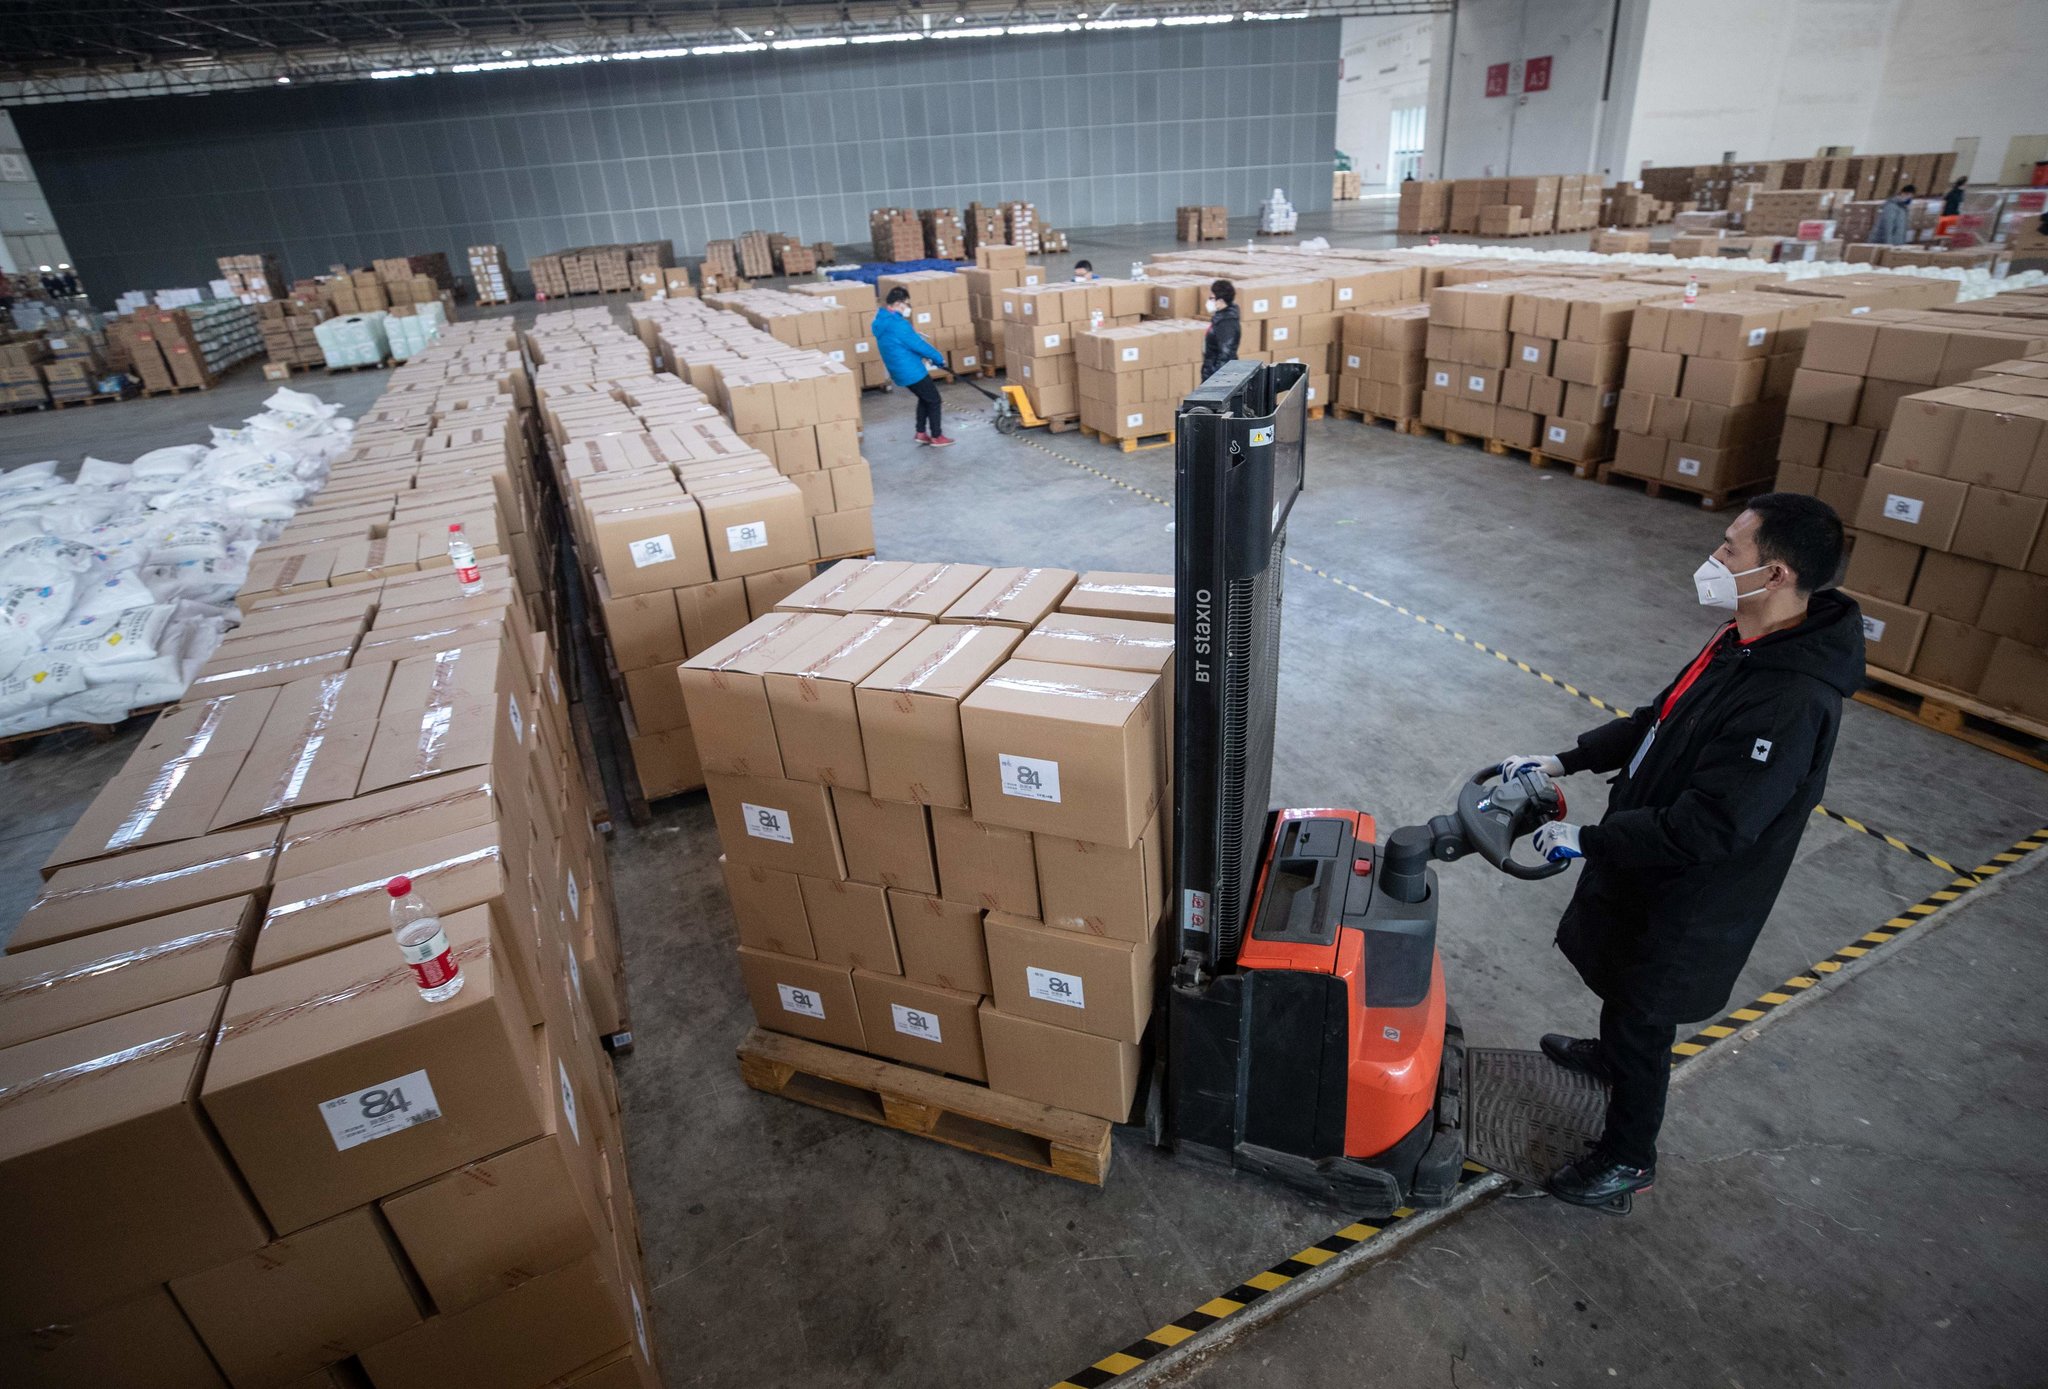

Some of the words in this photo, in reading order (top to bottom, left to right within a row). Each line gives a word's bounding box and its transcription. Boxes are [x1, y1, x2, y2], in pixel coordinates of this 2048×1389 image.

[1195, 660, 1210, 683] BT
[1016, 765, 1043, 790] 84
[758, 810, 781, 832] 84
[1048, 977, 1073, 997] 84
[792, 989, 813, 1009] 84
[906, 1011, 930, 1031] 84
[359, 1087, 412, 1118] 84
